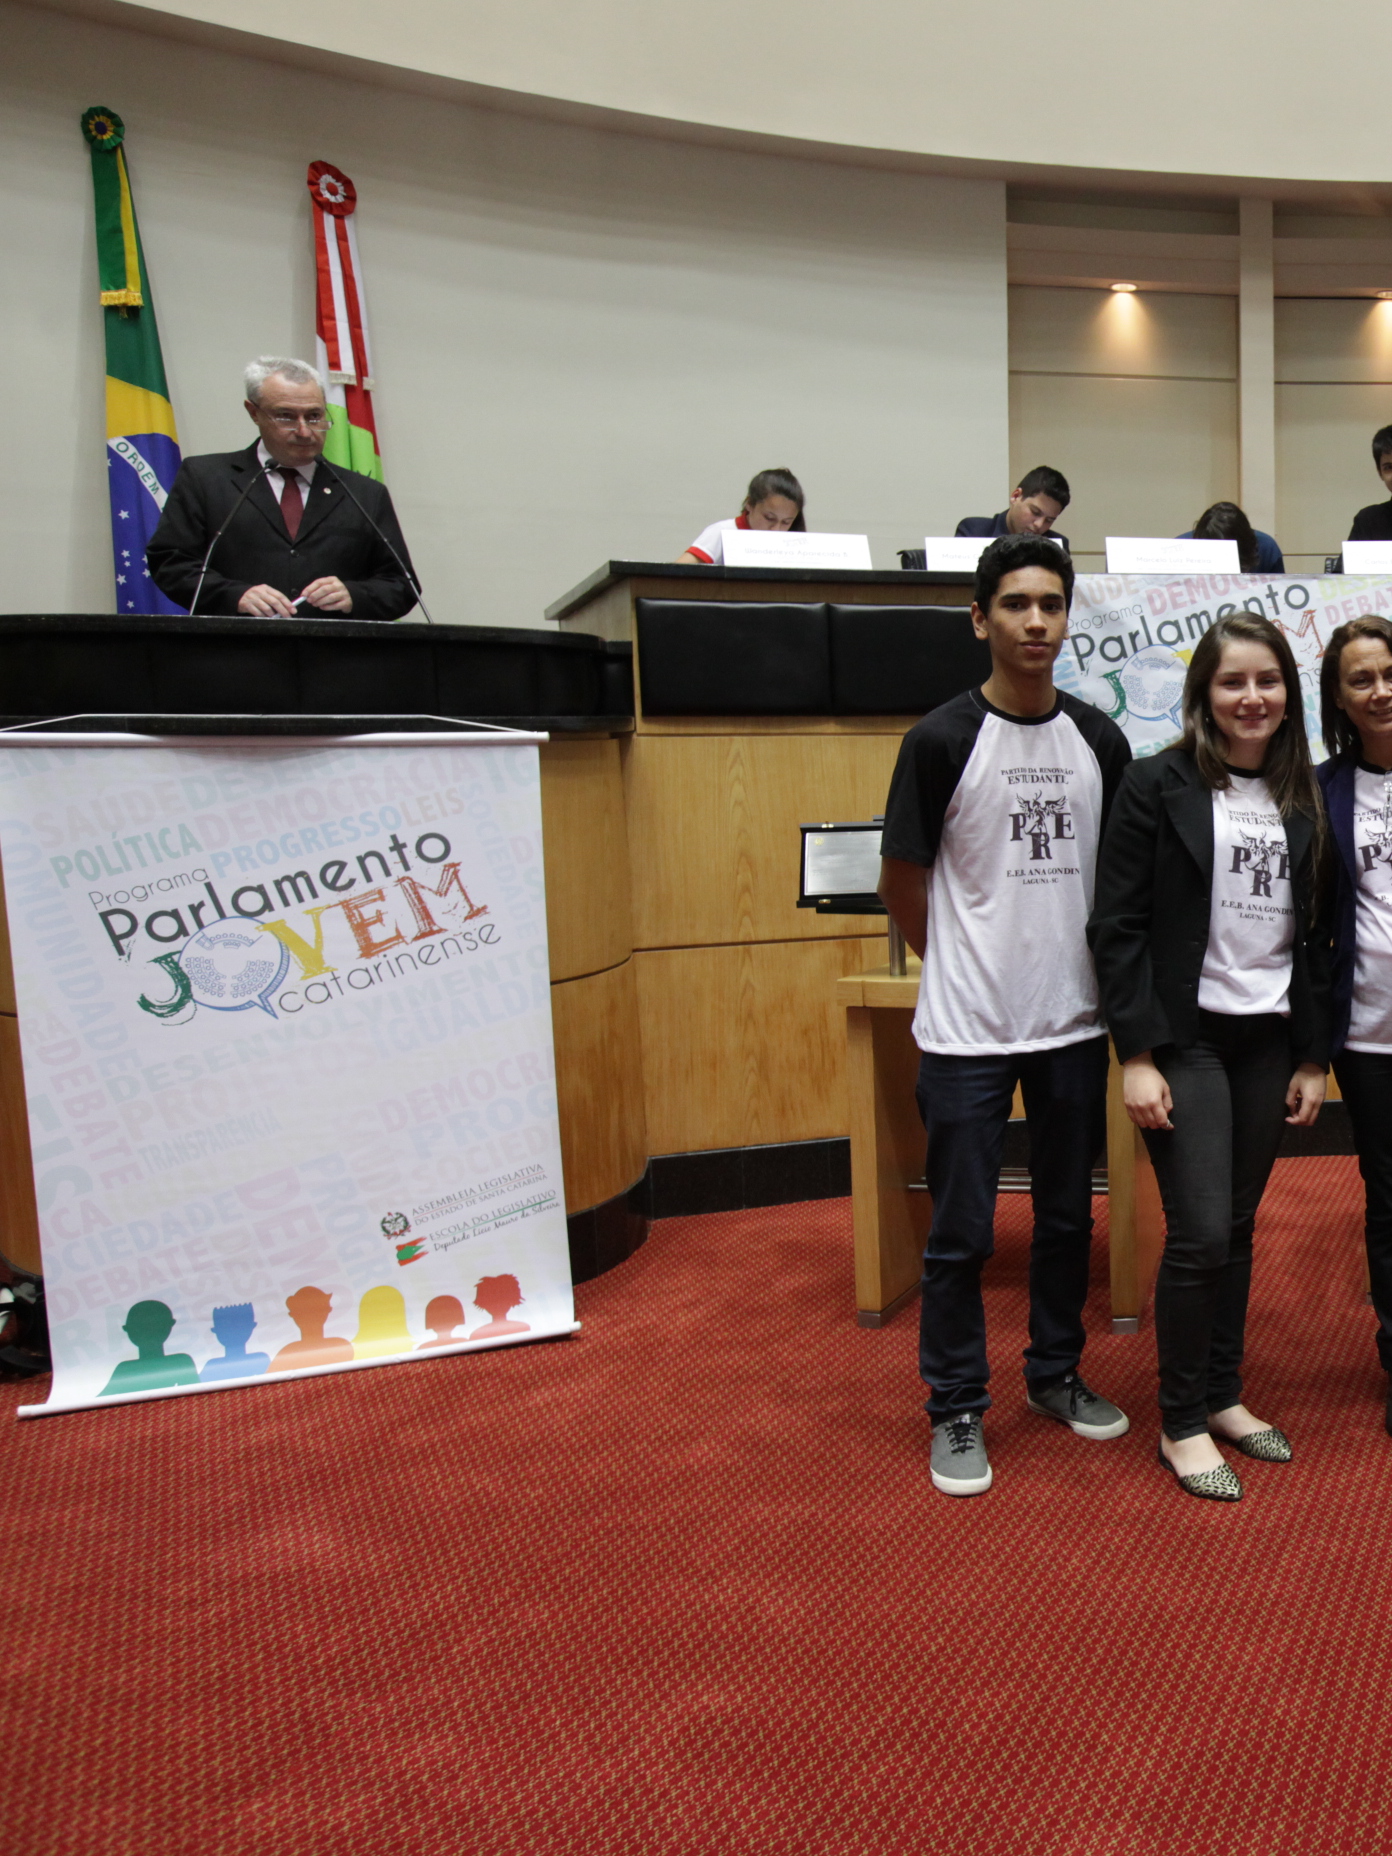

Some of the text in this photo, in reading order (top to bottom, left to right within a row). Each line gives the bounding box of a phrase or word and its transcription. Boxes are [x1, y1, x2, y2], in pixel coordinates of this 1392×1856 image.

[115, 441, 160, 495] ORDEM
[1070, 583, 1311, 672] Parlamento
[50, 823, 204, 889] POLÍTICA
[193, 751, 479, 850] DEMOCRACIA
[210, 804, 403, 879] PROGRESSO
[401, 787, 466, 828] LEIS
[88, 868, 209, 911] Programa
[99, 832, 453, 958] Parlamento
[1028, 868, 1047, 877] ANA
[1221, 899, 1245, 910] E.E.B.
[1246, 903, 1264, 913] ANA
[1239, 912, 1264, 921] LAGUNA
[137, 861, 491, 1026] JOVEM
[278, 922, 503, 1015] catarinense
[36, 1038, 145, 1191] DEBATE
[411, 1163, 544, 1217] ASSEMBLEIA LEGISLATIVA
[429, 1189, 557, 1242] ESCOLA DO LEGISLATIVO
[430, 1201, 464, 1220] ESTADO
[478, 1187, 506, 1204] SANTA
[507, 1173, 548, 1191] CATARINA
